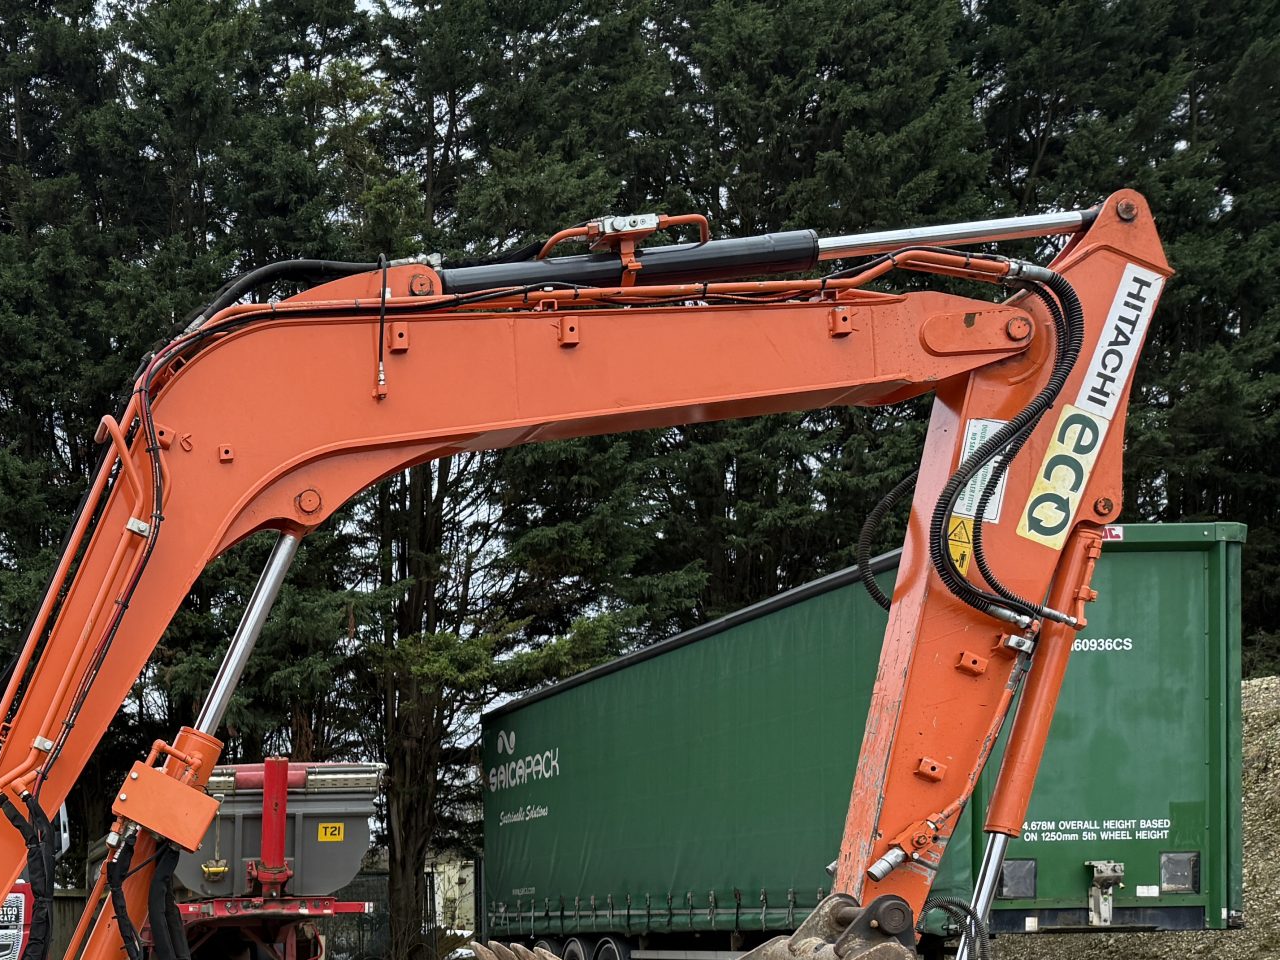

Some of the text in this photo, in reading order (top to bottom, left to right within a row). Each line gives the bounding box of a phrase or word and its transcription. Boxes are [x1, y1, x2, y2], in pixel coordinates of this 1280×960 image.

[1087, 276, 1152, 407] HITACHI
[489, 747, 559, 792] SAICAPACK
[322, 826, 341, 836] T21
[1022, 819, 1171, 831] 4.678M OVERALL HEIGHT BASED
[1023, 830, 1169, 842] ON 1250mm 5th WHEEL HEIGHT
